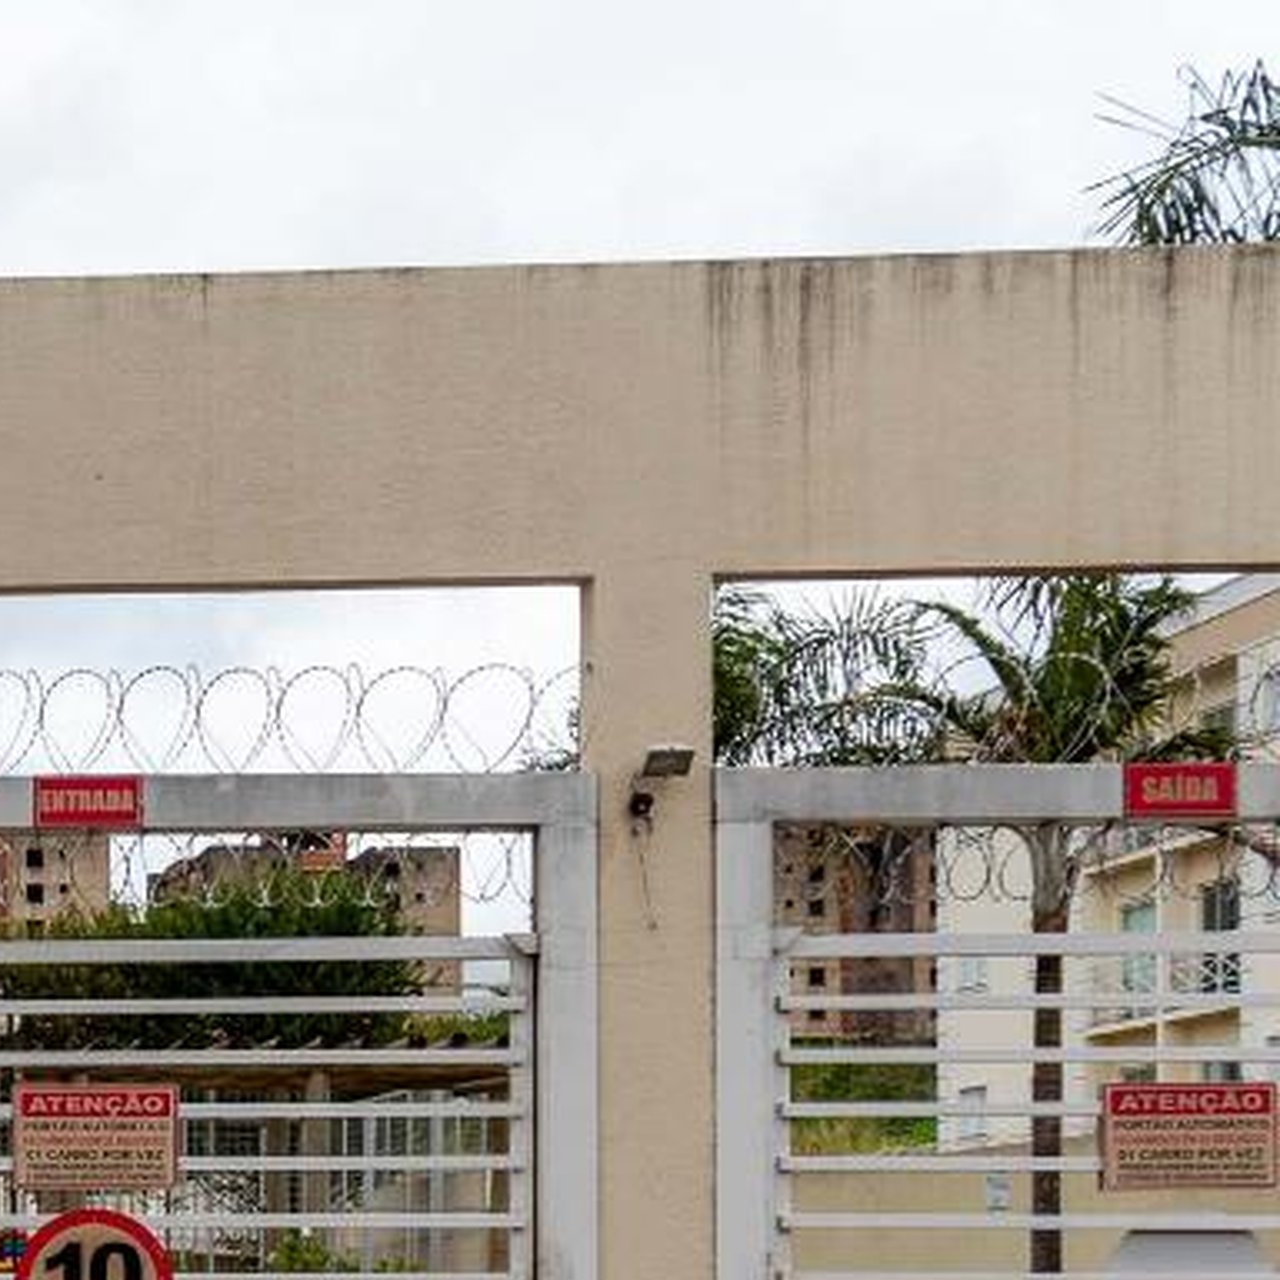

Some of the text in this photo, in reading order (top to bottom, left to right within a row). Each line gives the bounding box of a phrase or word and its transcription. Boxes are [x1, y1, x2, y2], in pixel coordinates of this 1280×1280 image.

[40, 788, 135, 812] ENTRADA
[1141, 773, 1219, 803] SAÍDA
[27, 1093, 164, 1117] ATENÇÃO
[1117, 1092, 1264, 1114] ATENÇÃO
